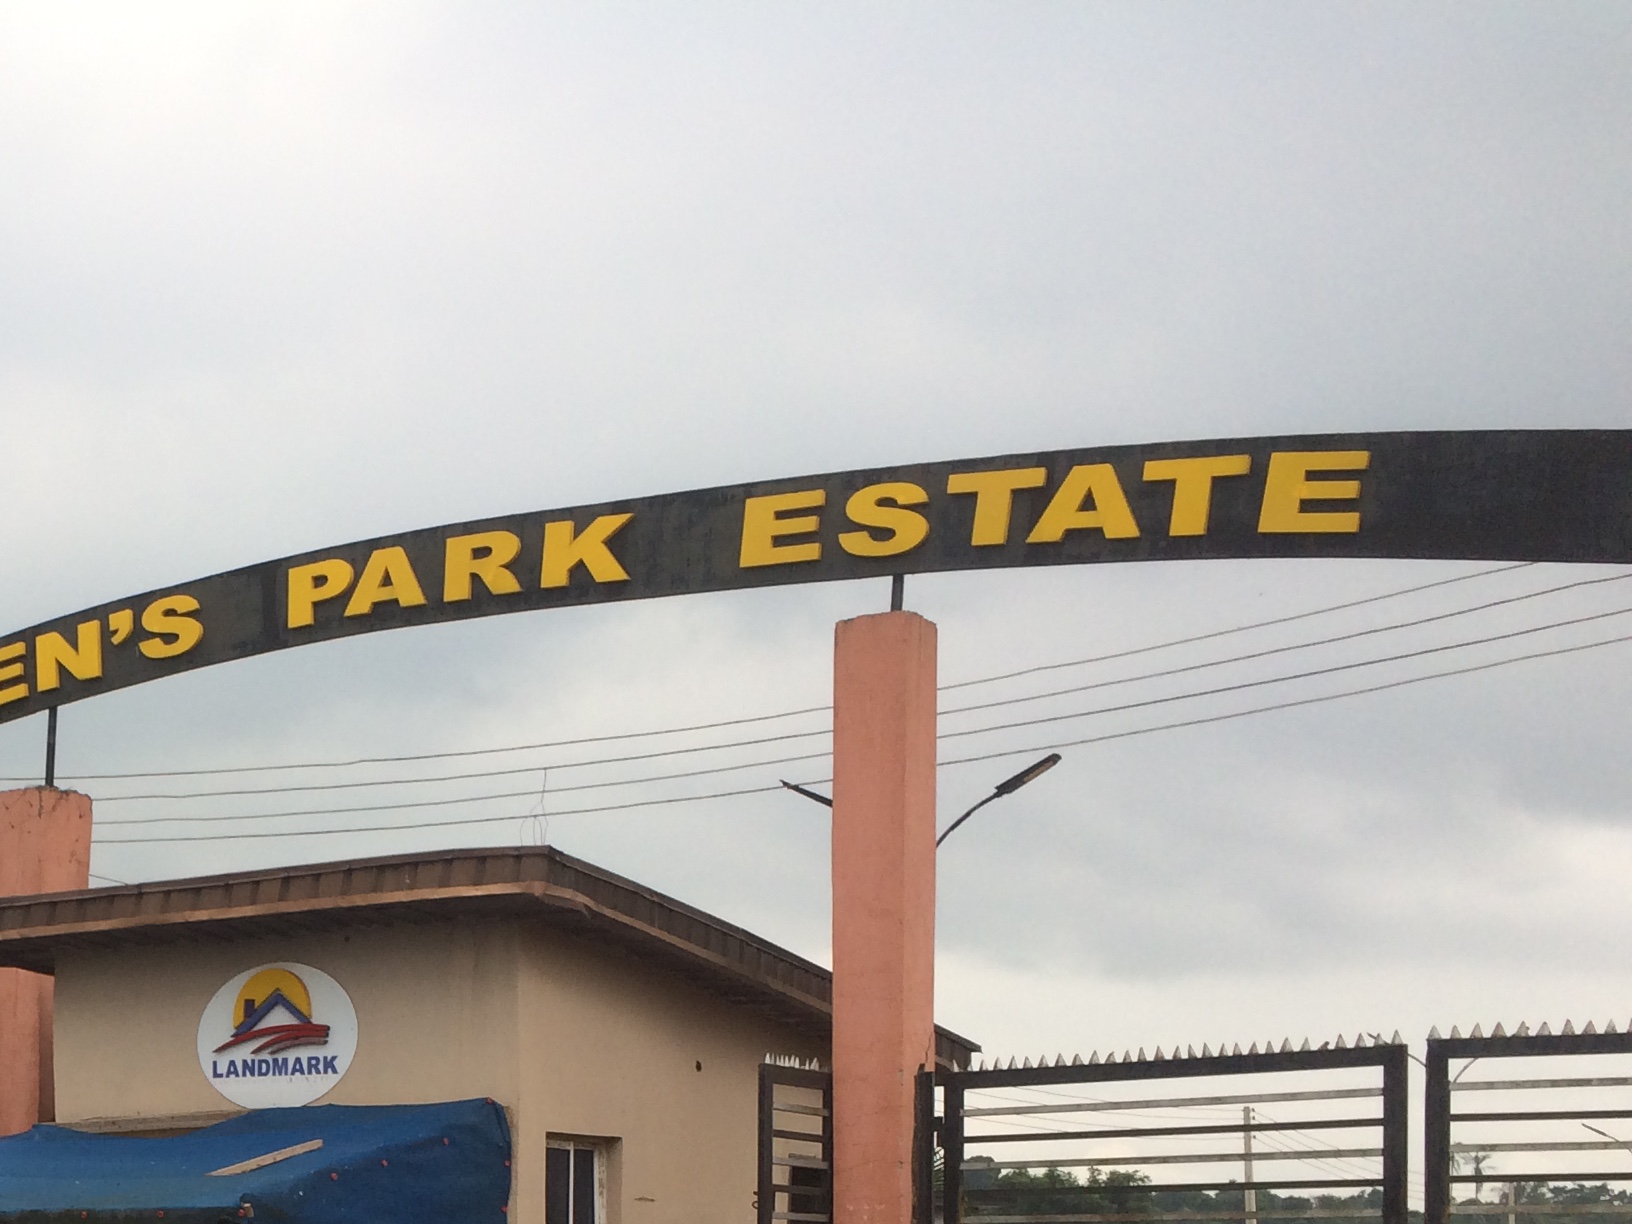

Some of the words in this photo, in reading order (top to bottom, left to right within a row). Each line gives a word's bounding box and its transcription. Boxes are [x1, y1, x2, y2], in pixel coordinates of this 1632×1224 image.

[286, 512, 634, 629] PARK
[738, 449, 1372, 568] ESTATE
[212, 1055, 339, 1079] LANDMARK
